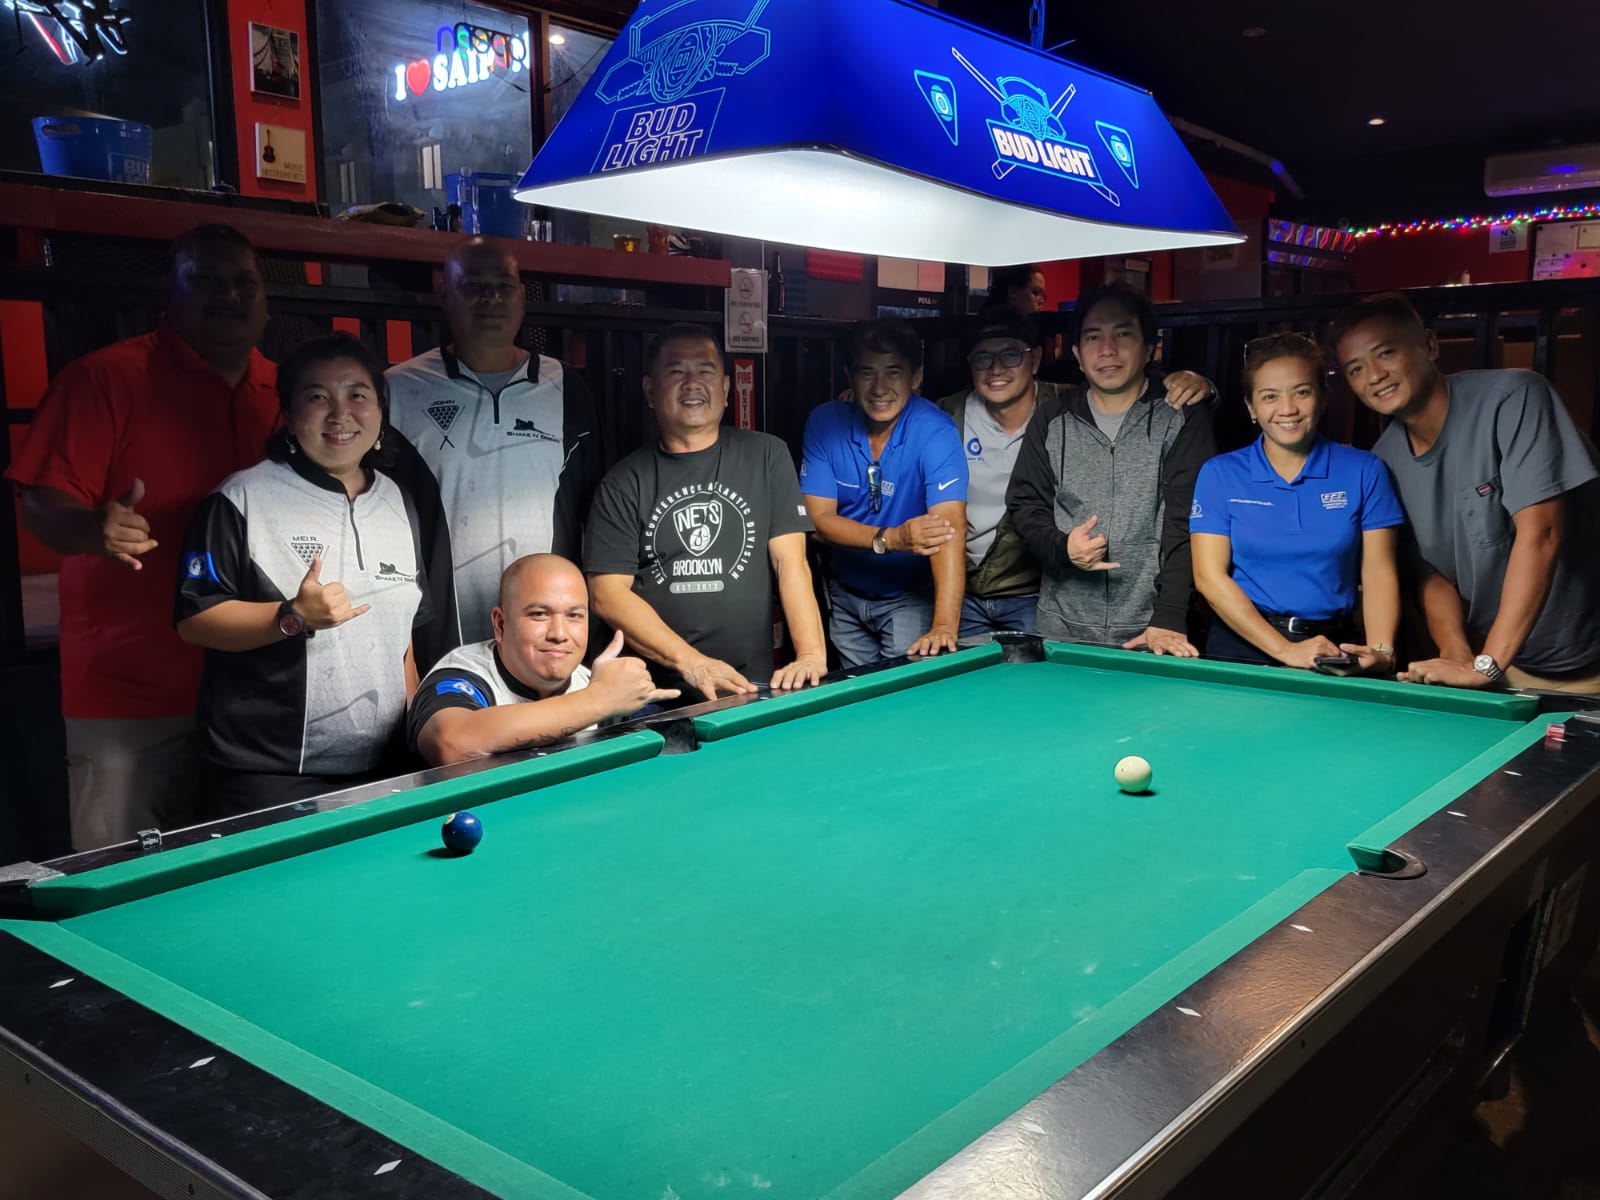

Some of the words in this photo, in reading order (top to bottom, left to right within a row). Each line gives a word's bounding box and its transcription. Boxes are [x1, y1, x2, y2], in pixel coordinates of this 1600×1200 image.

[625, 102, 697, 142] BUD
[601, 129, 704, 171] LIGHT
[992, 127, 1040, 164] BUD
[1038, 139, 1096, 178] LIGHT
[737, 372, 752, 385] FIRE
[677, 502, 720, 533] NETS
[672, 557, 723, 576] BROOKLYN
[730, 521, 757, 581] DIVISION
